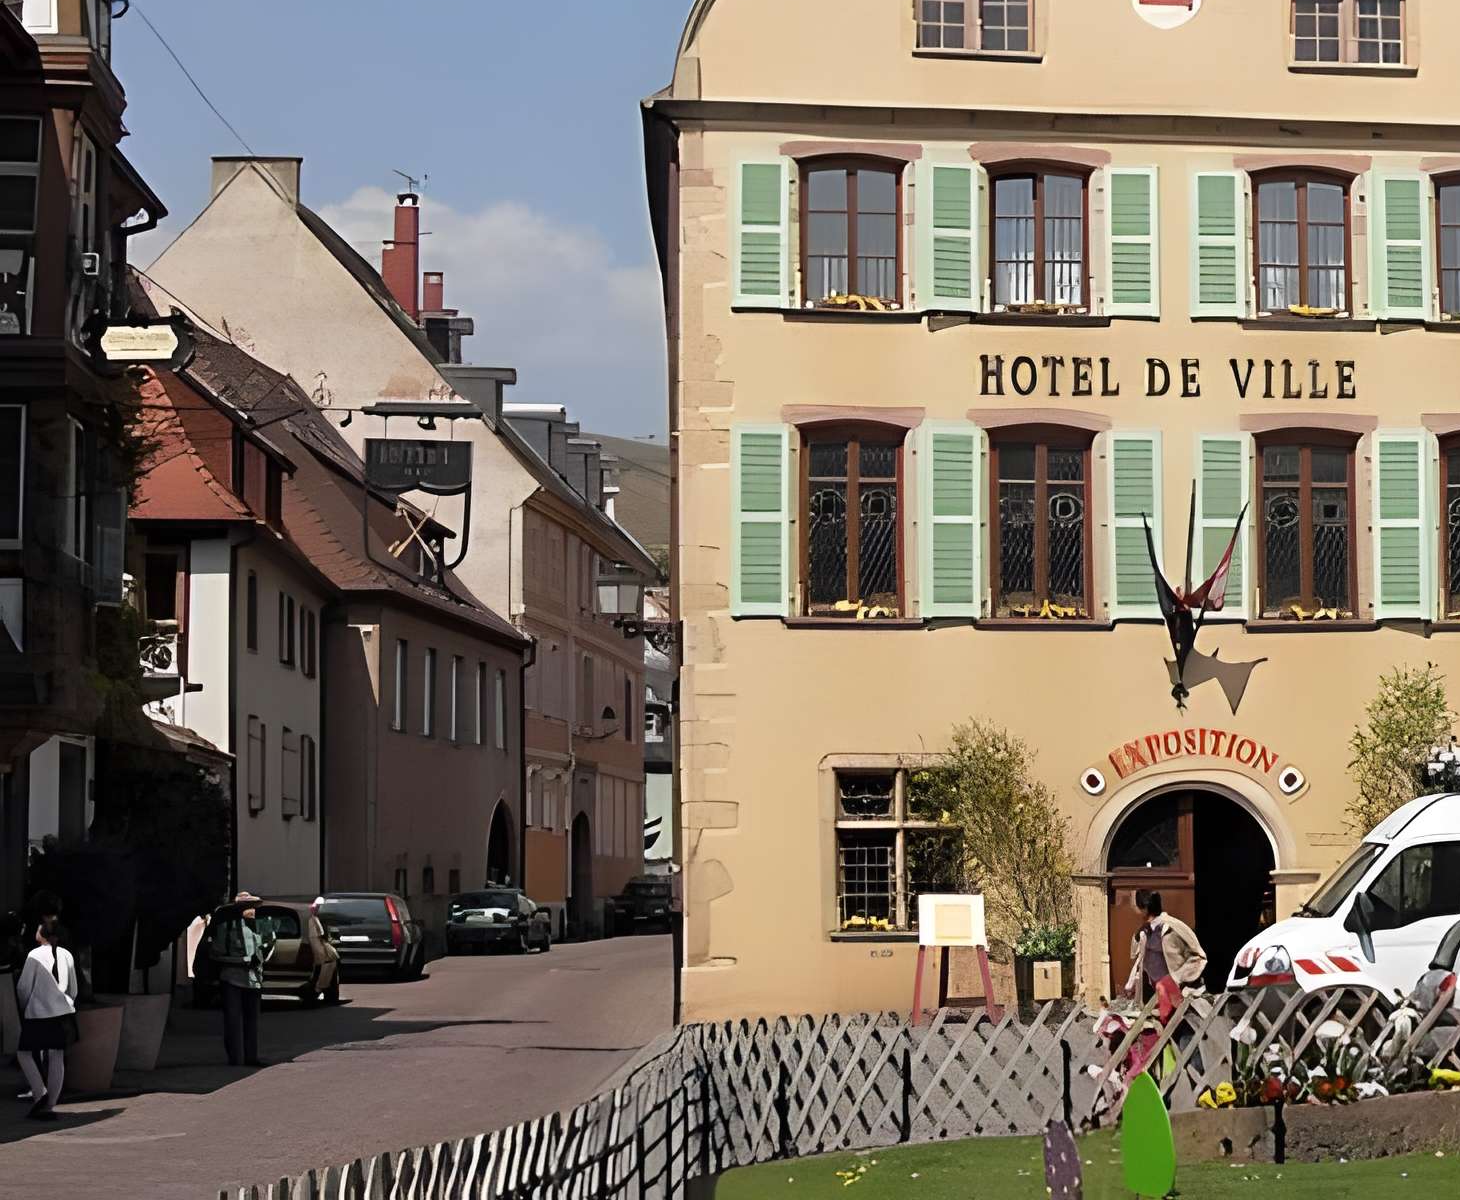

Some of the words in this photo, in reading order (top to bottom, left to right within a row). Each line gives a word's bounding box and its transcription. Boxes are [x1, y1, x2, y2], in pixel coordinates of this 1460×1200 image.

[979, 353, 1120, 397] HOTEL
[1145, 357, 1201, 398] DE
[1229, 358, 1357, 399] VILLE
